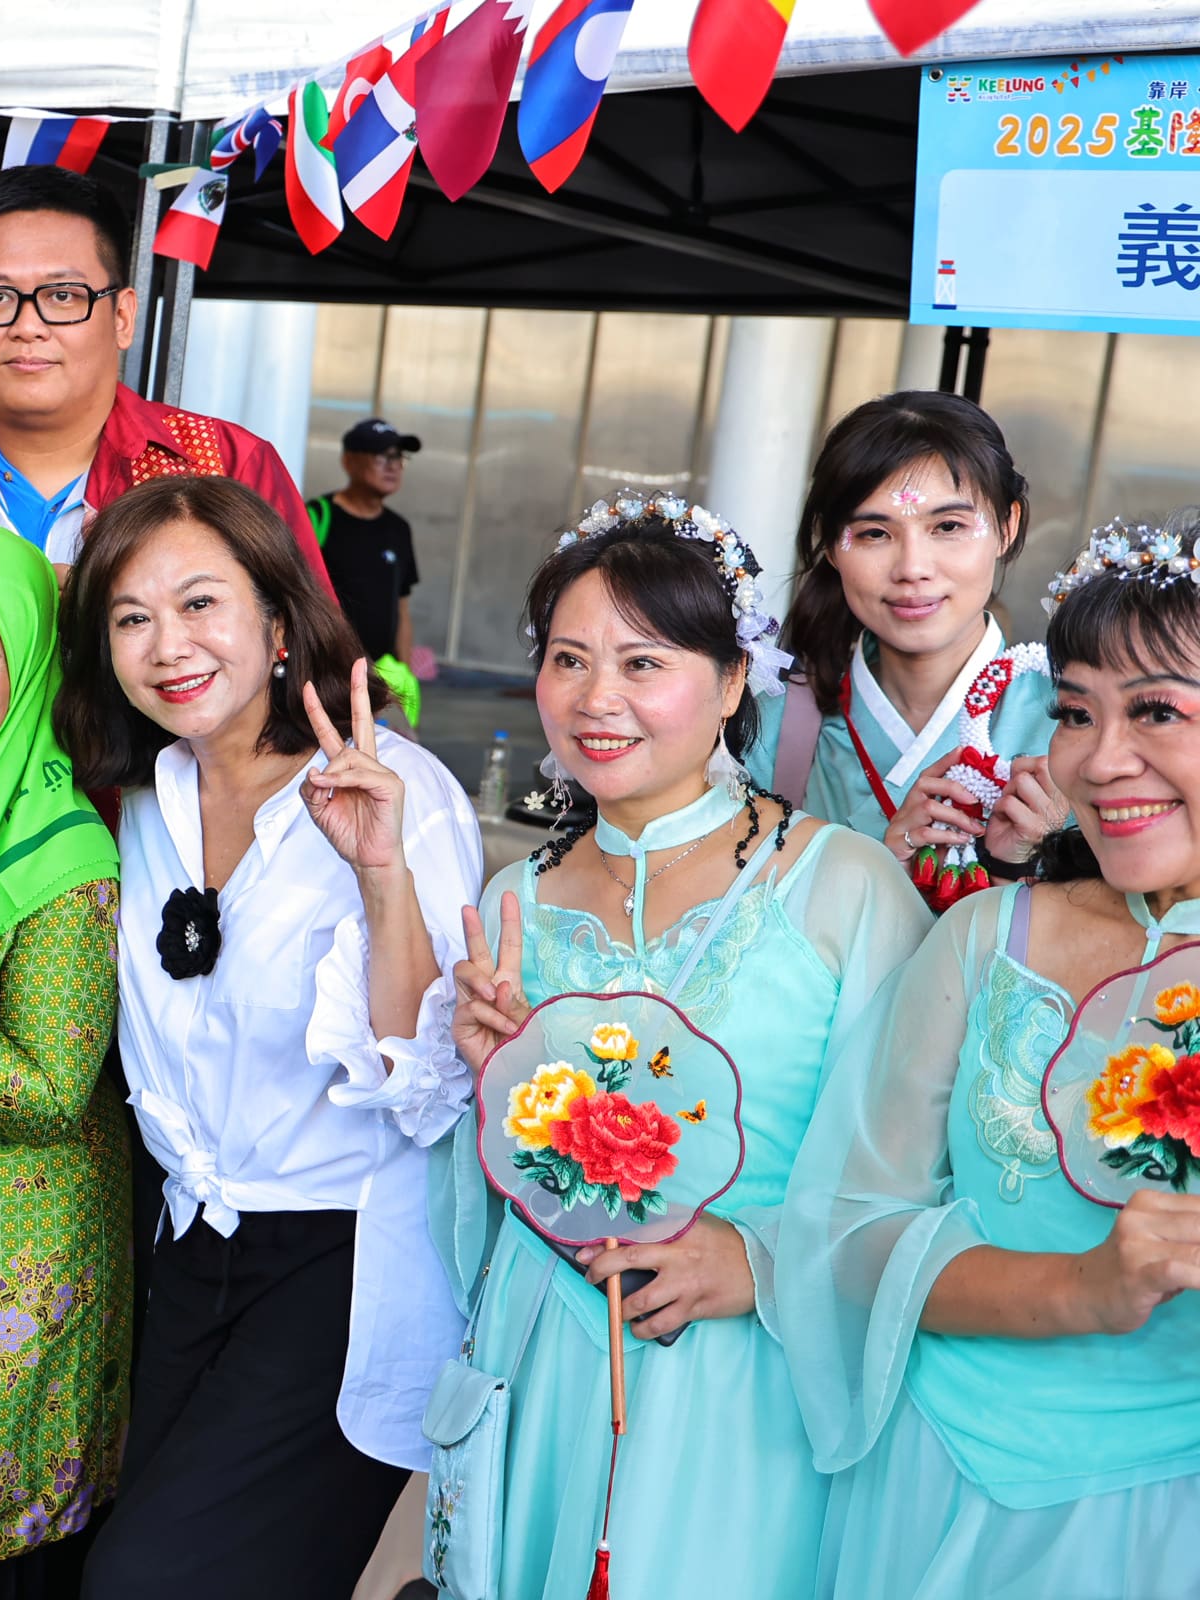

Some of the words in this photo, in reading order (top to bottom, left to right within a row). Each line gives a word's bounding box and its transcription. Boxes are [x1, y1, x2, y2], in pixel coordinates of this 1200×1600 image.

[978, 77, 1045, 93] KEELUNG
[1148, 81, 1188, 99] 靠岸
[1116, 202, 1200, 291] 義
